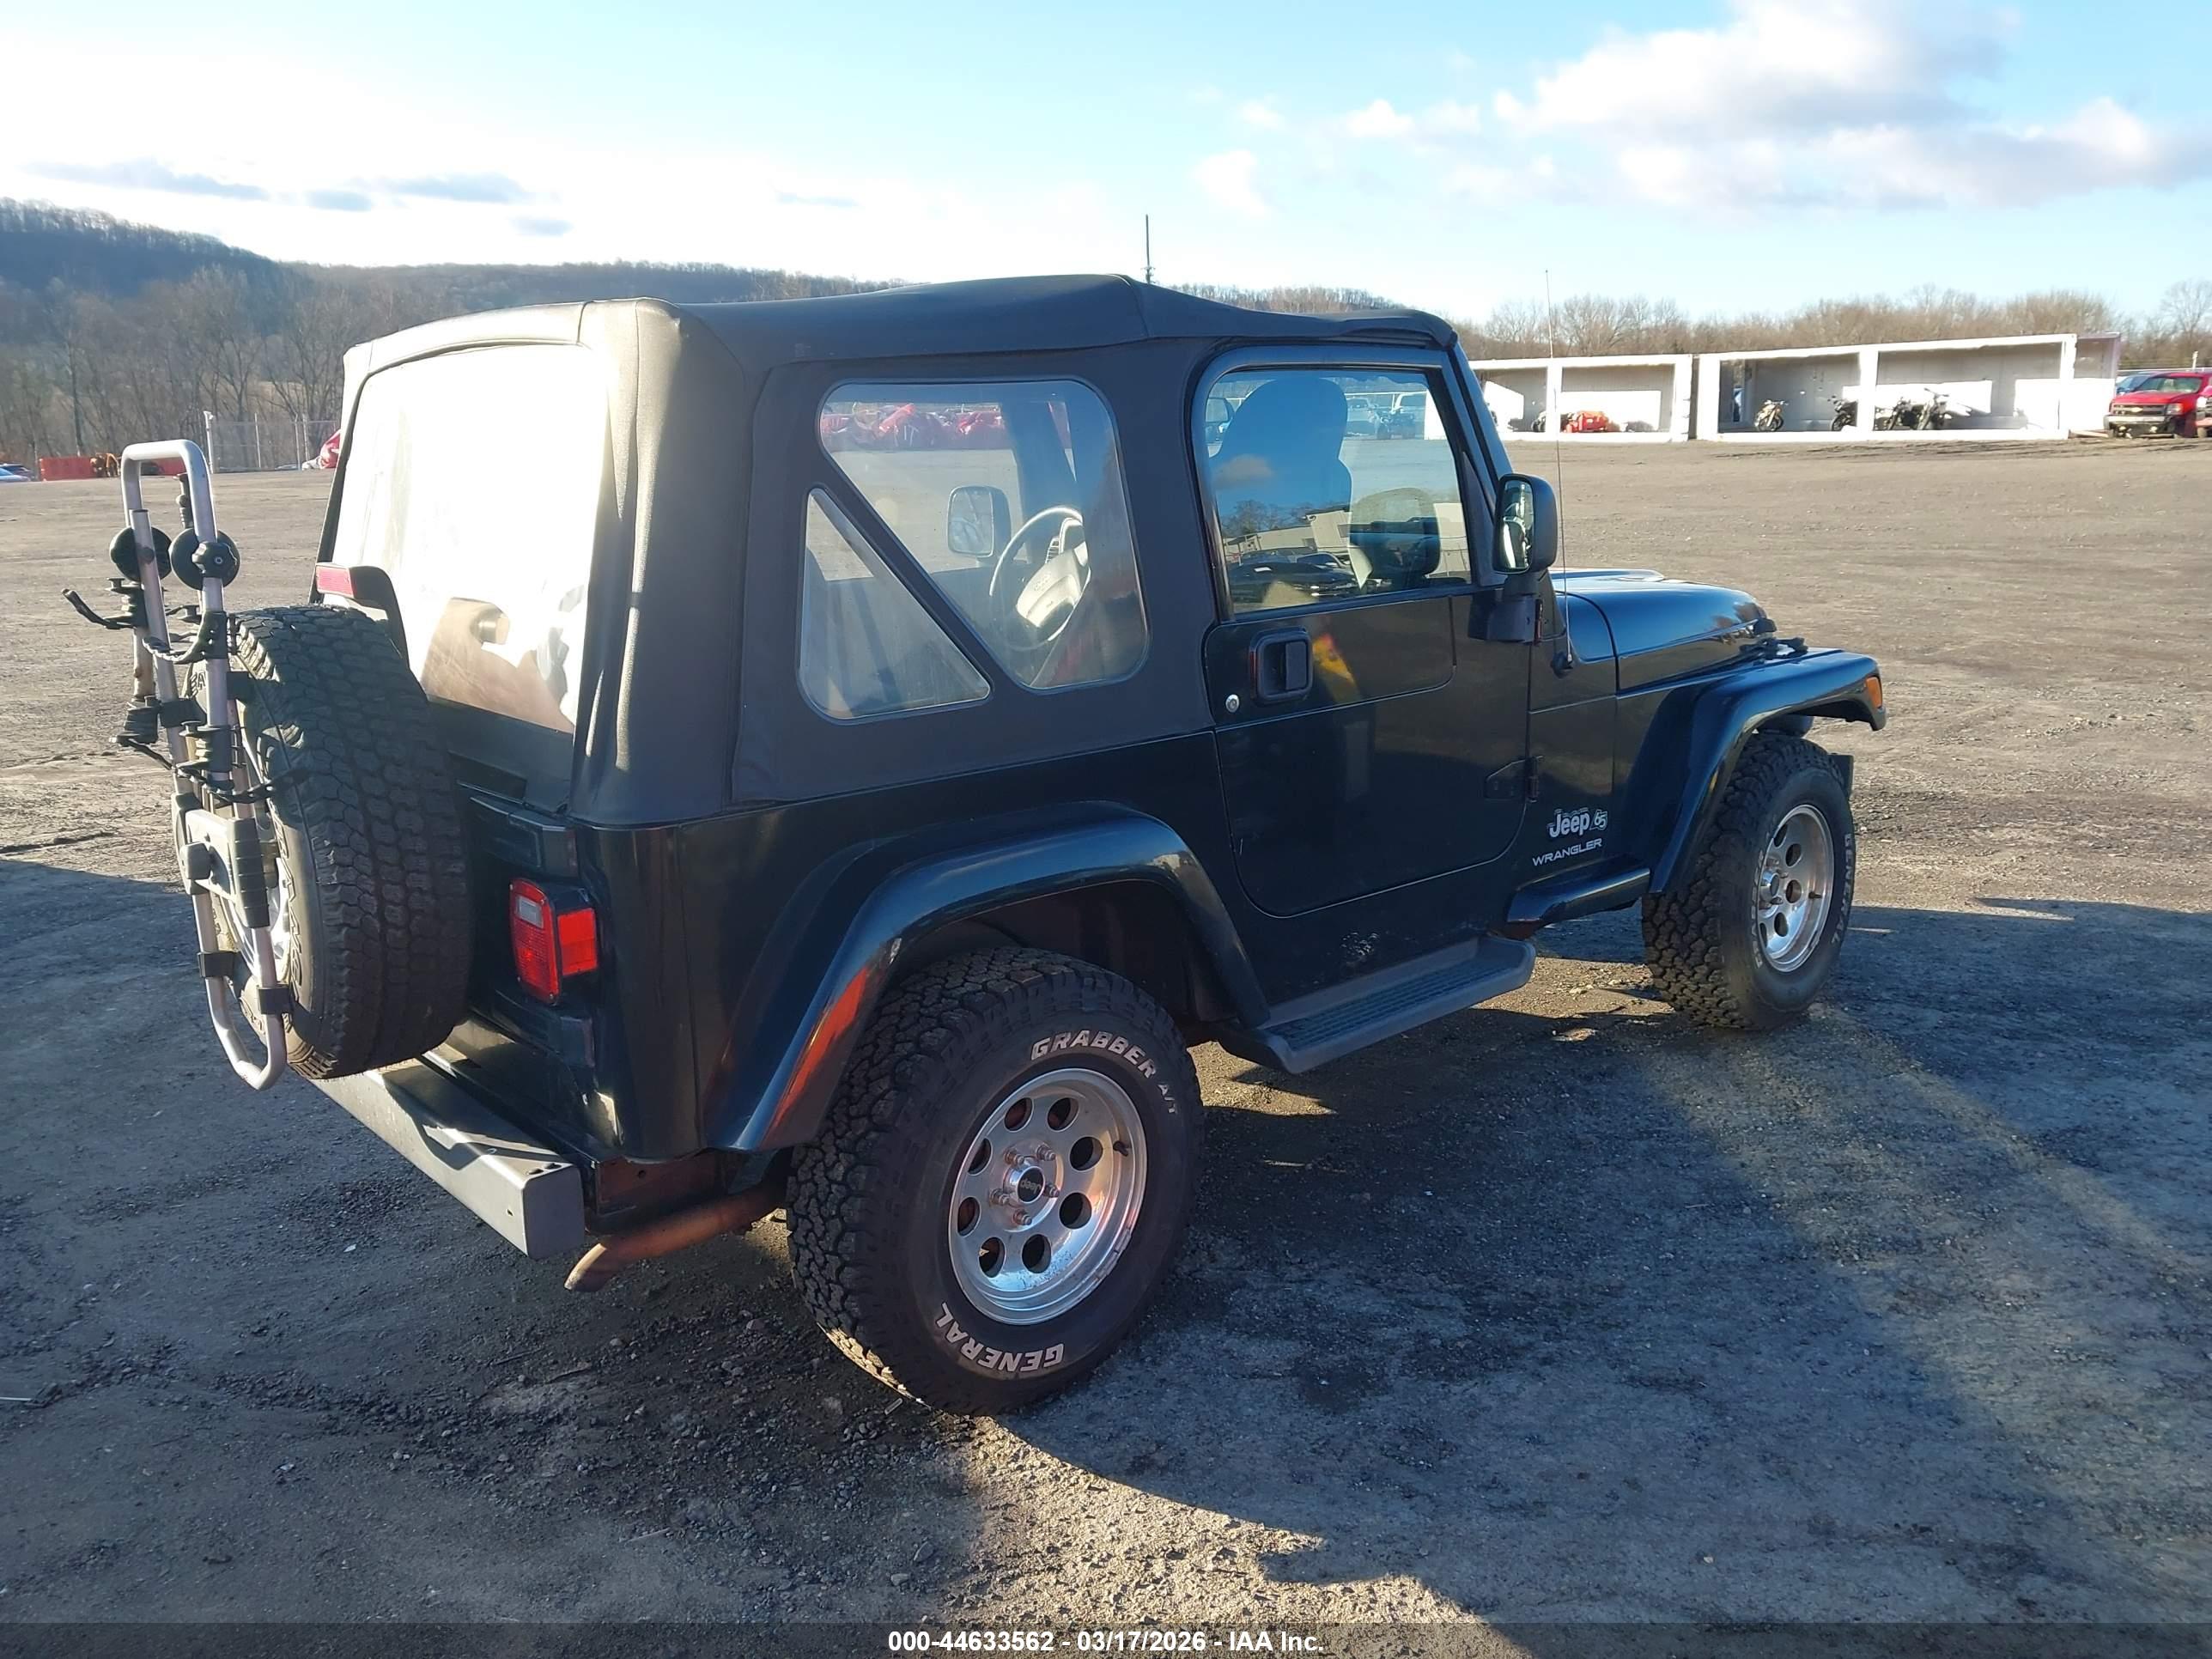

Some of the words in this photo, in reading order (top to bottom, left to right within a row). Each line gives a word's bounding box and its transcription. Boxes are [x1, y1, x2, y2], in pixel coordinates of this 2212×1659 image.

[1548, 809, 1590, 837] Jeep
[1532, 837, 1602, 866] WRANGLER
[1030, 1030, 1157, 1079] GRABBER
[1158, 1084, 1178, 1115] A/T
[936, 1302, 1065, 1372] GENERAL
